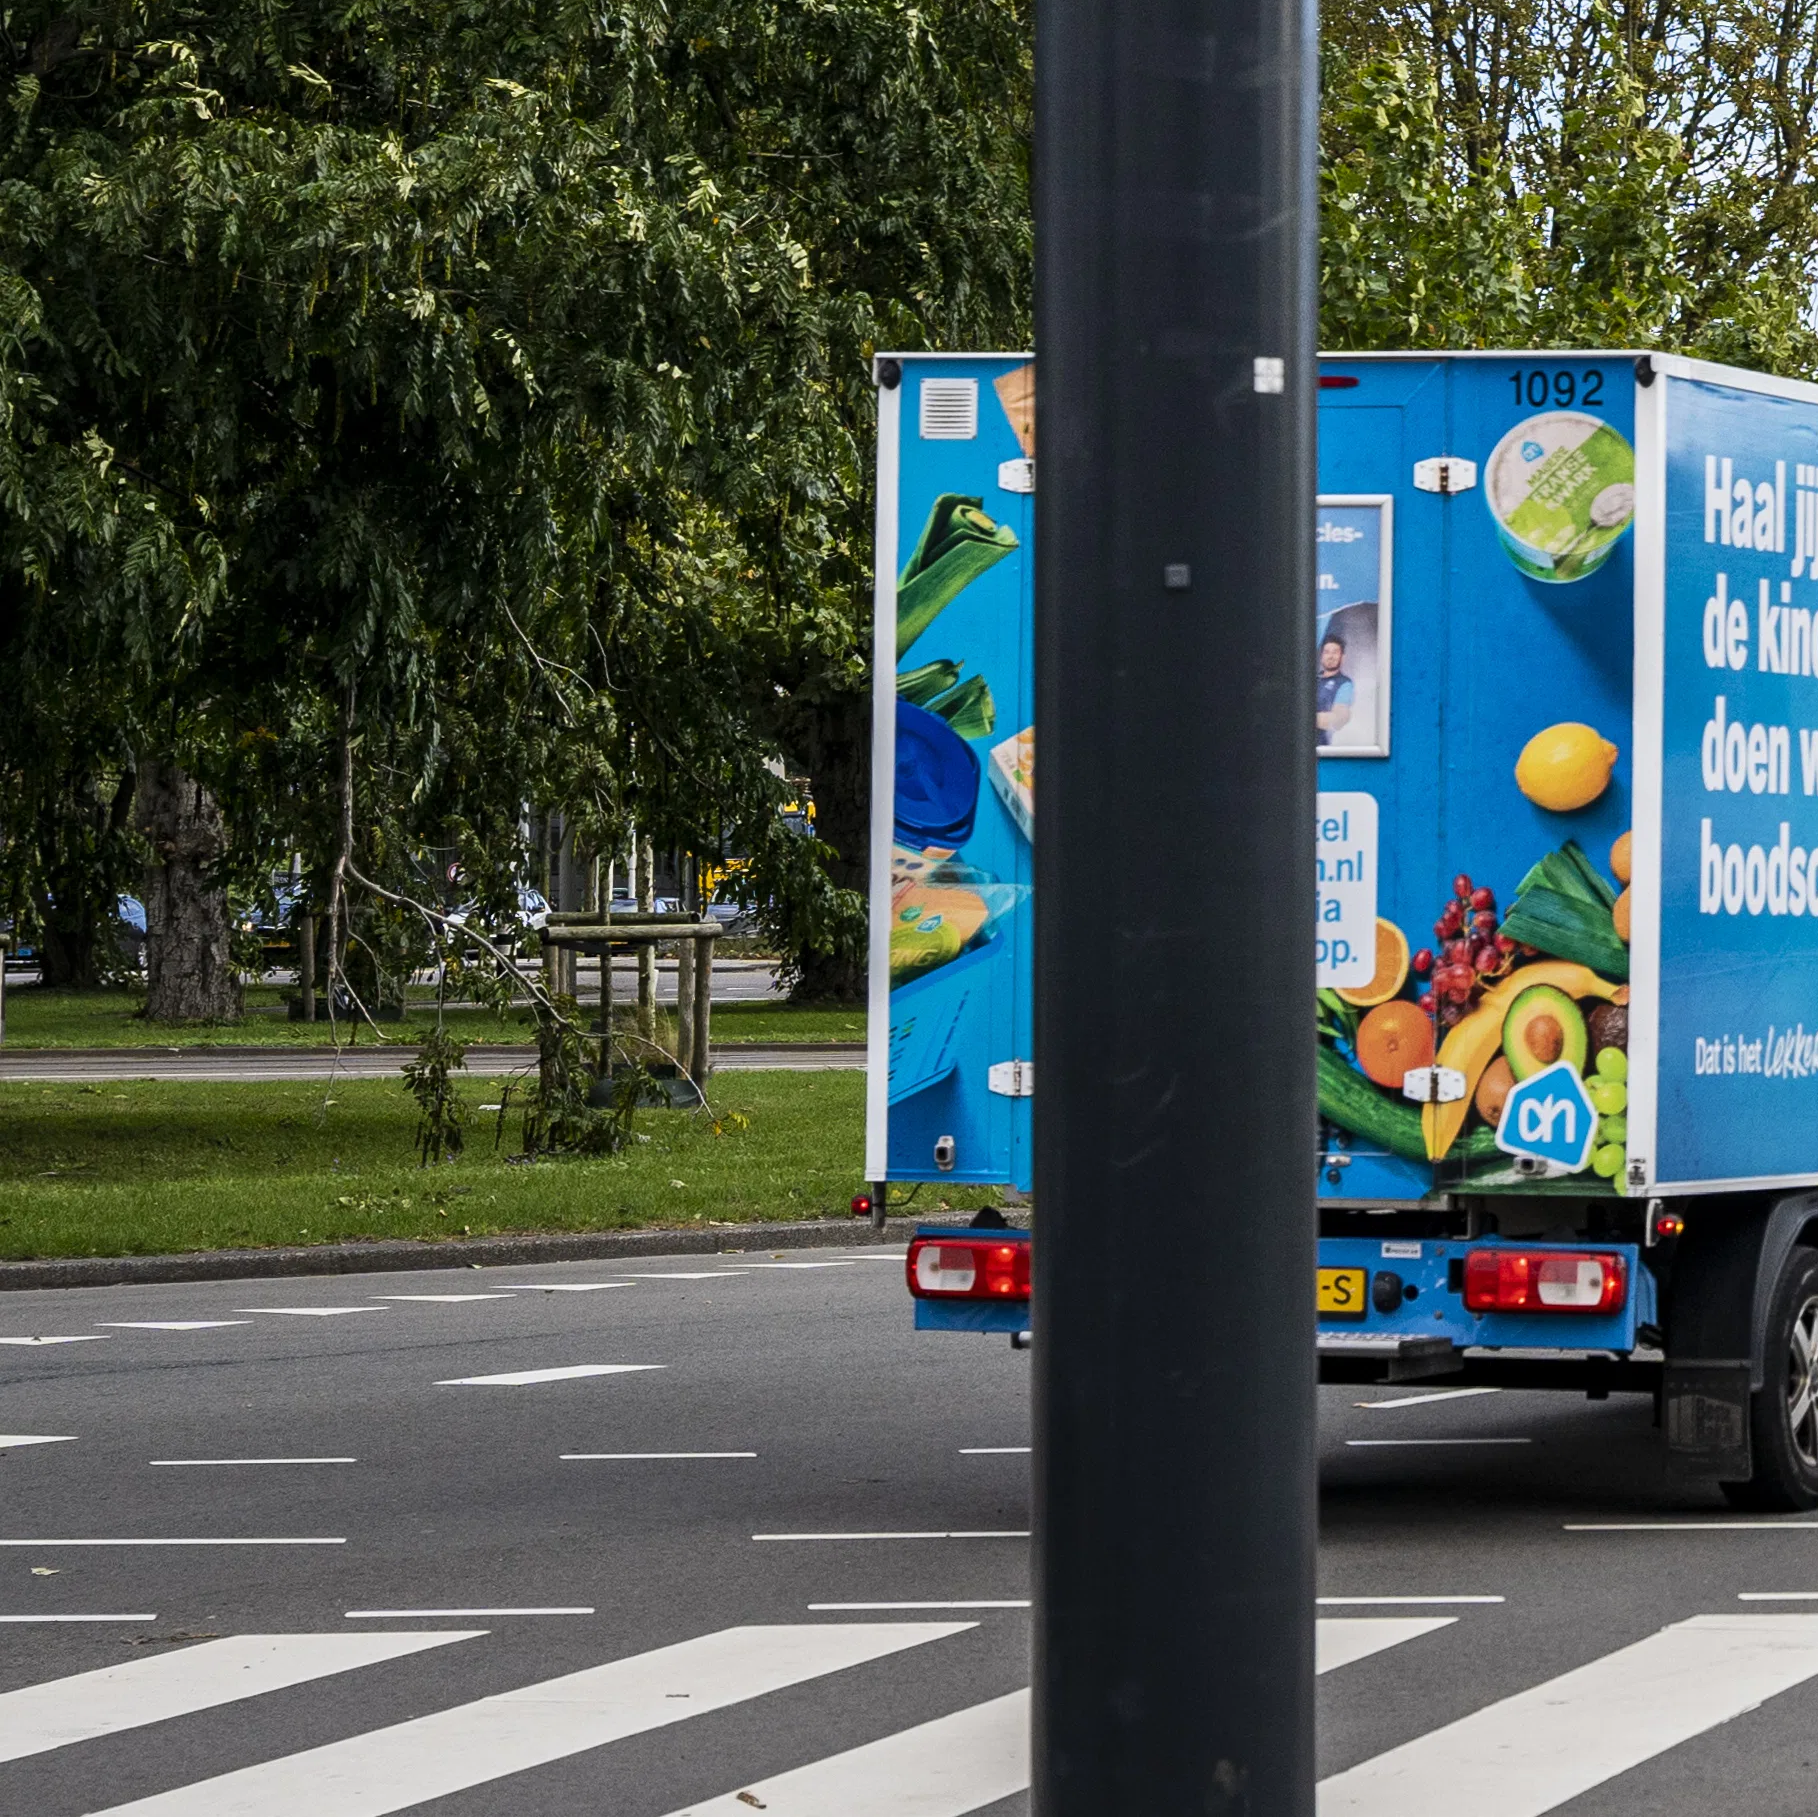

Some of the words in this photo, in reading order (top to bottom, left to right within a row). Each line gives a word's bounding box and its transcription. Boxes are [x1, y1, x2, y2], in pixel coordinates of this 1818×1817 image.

[1508, 370, 1604, 408] 1092
[1704, 454, 1786, 554] Haal
[1702, 572, 1749, 671] de
[1700, 695, 1791, 794] doen
[1695, 1037, 1721, 1075] Dat
[1722, 1034, 1736, 1074] is
[1737, 1033, 1763, 1074] het
